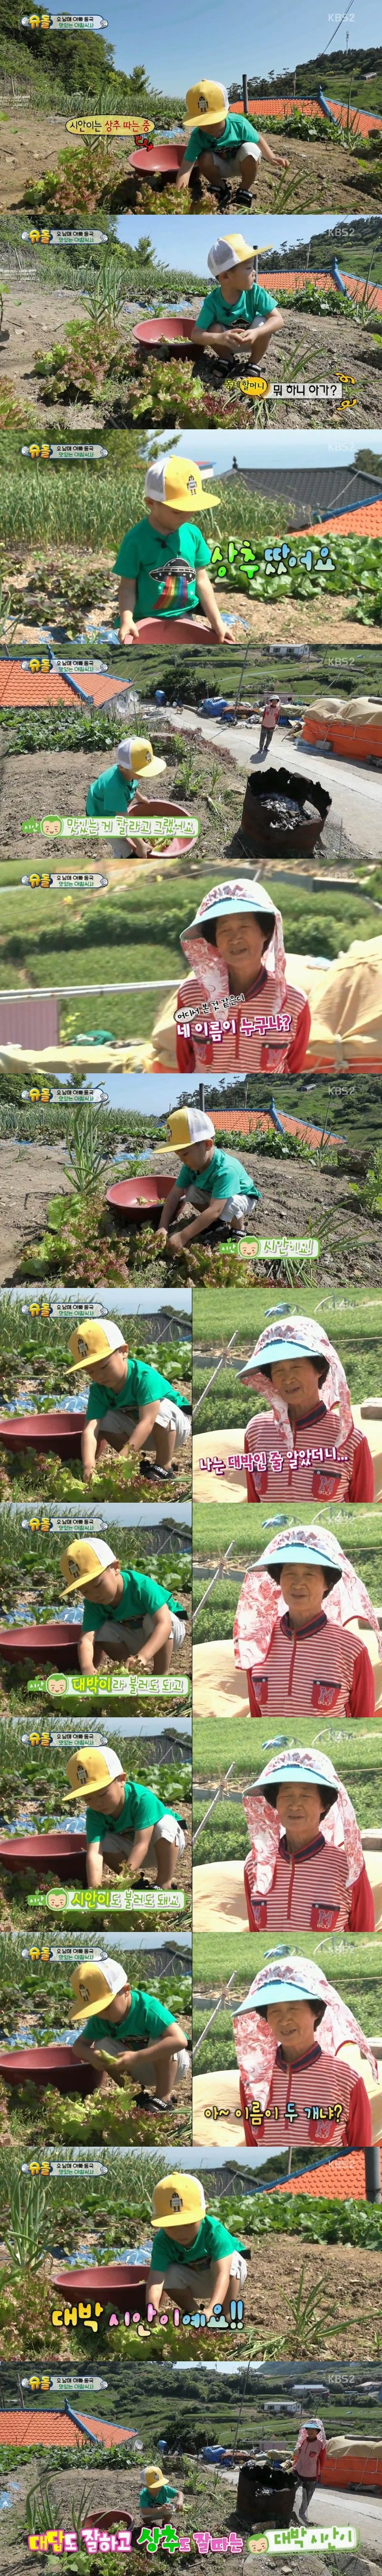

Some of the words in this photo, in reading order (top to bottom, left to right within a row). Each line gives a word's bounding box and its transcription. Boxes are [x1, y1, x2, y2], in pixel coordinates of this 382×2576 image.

[319, 1476, 335, 1492] M
[318, 1686, 335, 1702] M
[318, 1909, 334, 1926] M
[316, 2121, 332, 2135] M
